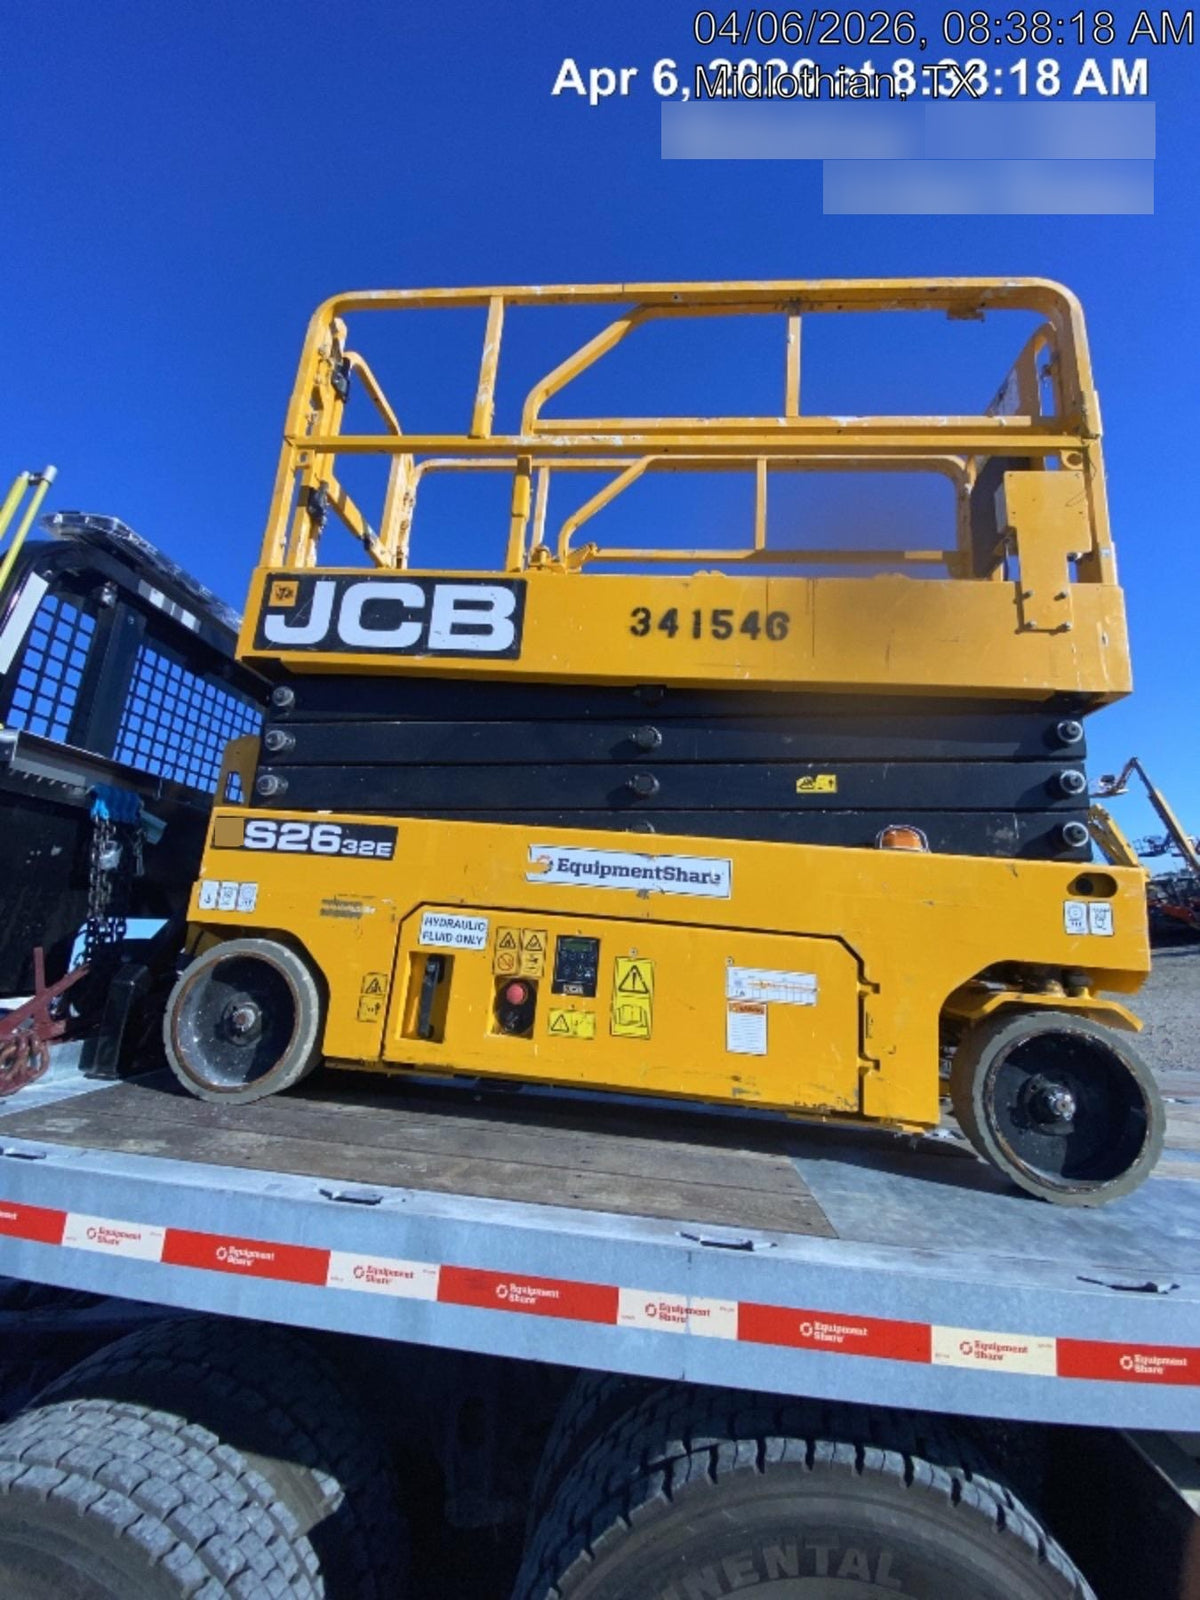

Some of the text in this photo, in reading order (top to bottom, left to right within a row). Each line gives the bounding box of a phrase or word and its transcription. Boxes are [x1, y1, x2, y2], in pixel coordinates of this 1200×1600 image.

[264, 580, 517, 652] JCB
[629, 606, 791, 641] 341546
[243, 820, 393, 857] S26 32E
[422, 930, 484, 946] FLUID ONLY
[424, 916, 486, 932] HYDRAULIC
